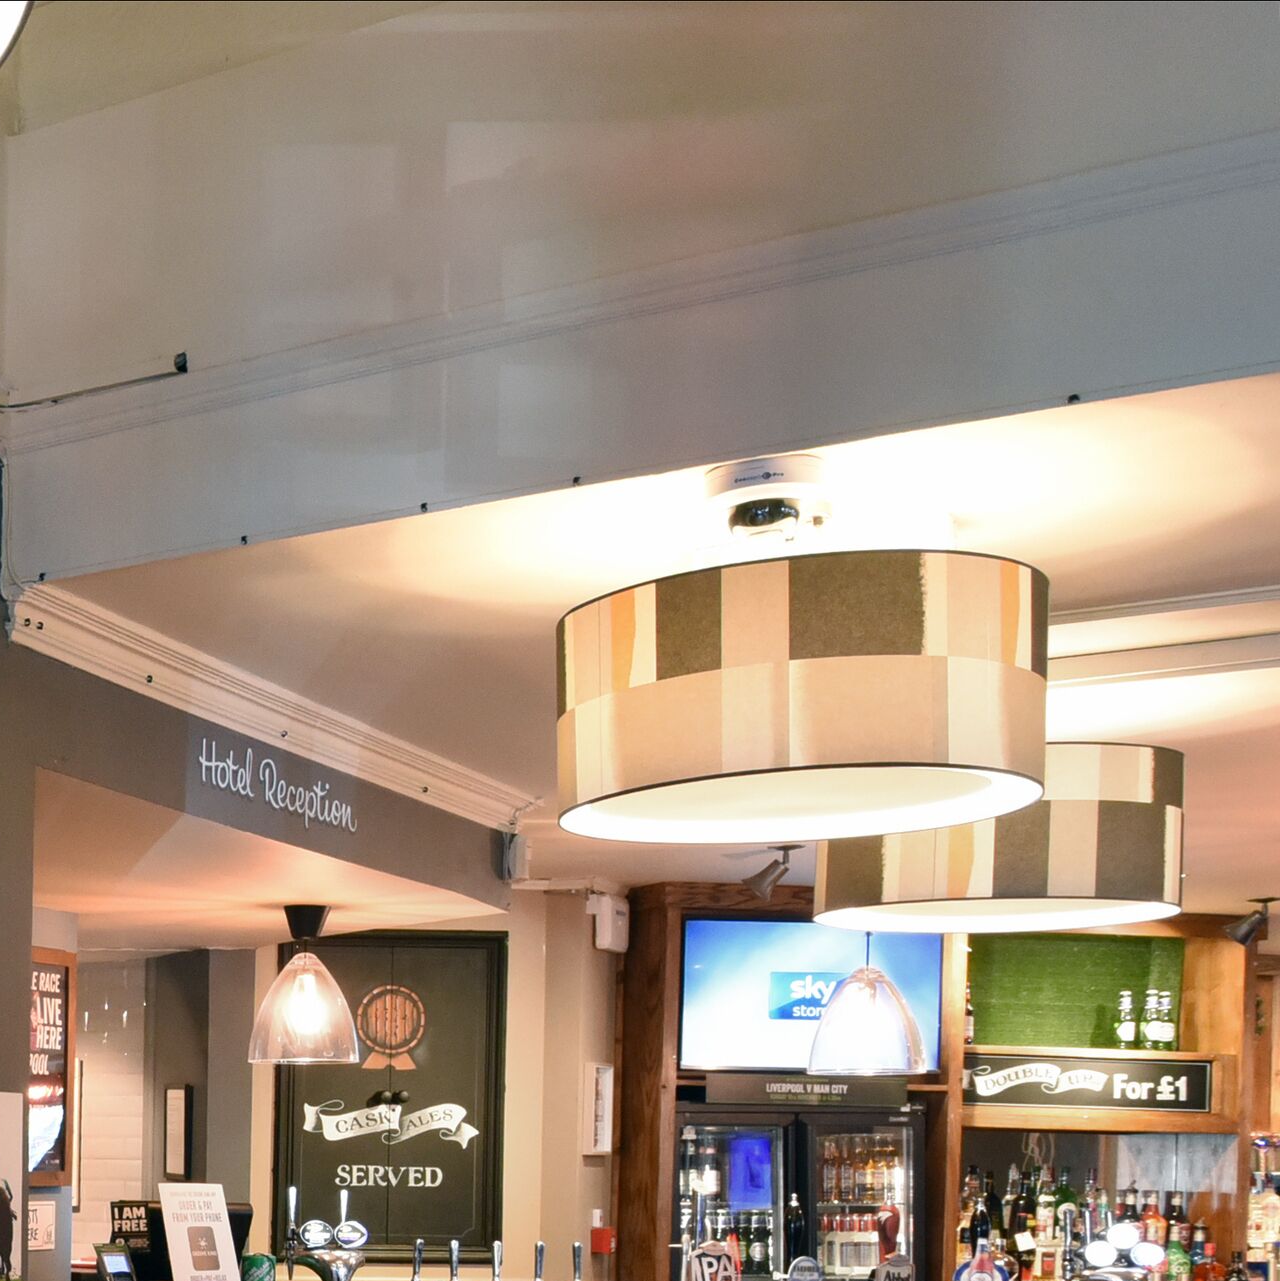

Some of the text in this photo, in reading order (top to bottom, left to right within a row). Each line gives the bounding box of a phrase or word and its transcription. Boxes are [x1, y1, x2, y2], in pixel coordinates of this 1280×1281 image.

[199, 738, 357, 832] Hotel Reception
[40, 972, 60, 993] RACE
[790, 976, 836, 1004] sky
[37, 997, 62, 1025] LIVE
[37, 1027, 61, 1050] HERE
[766, 1083, 805, 1093] LIVERPOOL
[813, 1084, 830, 1093] MAN
[831, 1085, 848, 1094] CITY
[984, 1067, 1053, 1090] DOUBLE
[1113, 1074, 1154, 1100] For
[1156, 1076, 1187, 1101] £1
[335, 1109, 453, 1134] CASK ALES
[335, 1165, 443, 1188] SERVED
[114, 1207, 145, 1219] I AM
[114, 1219, 148, 1232] FREE
